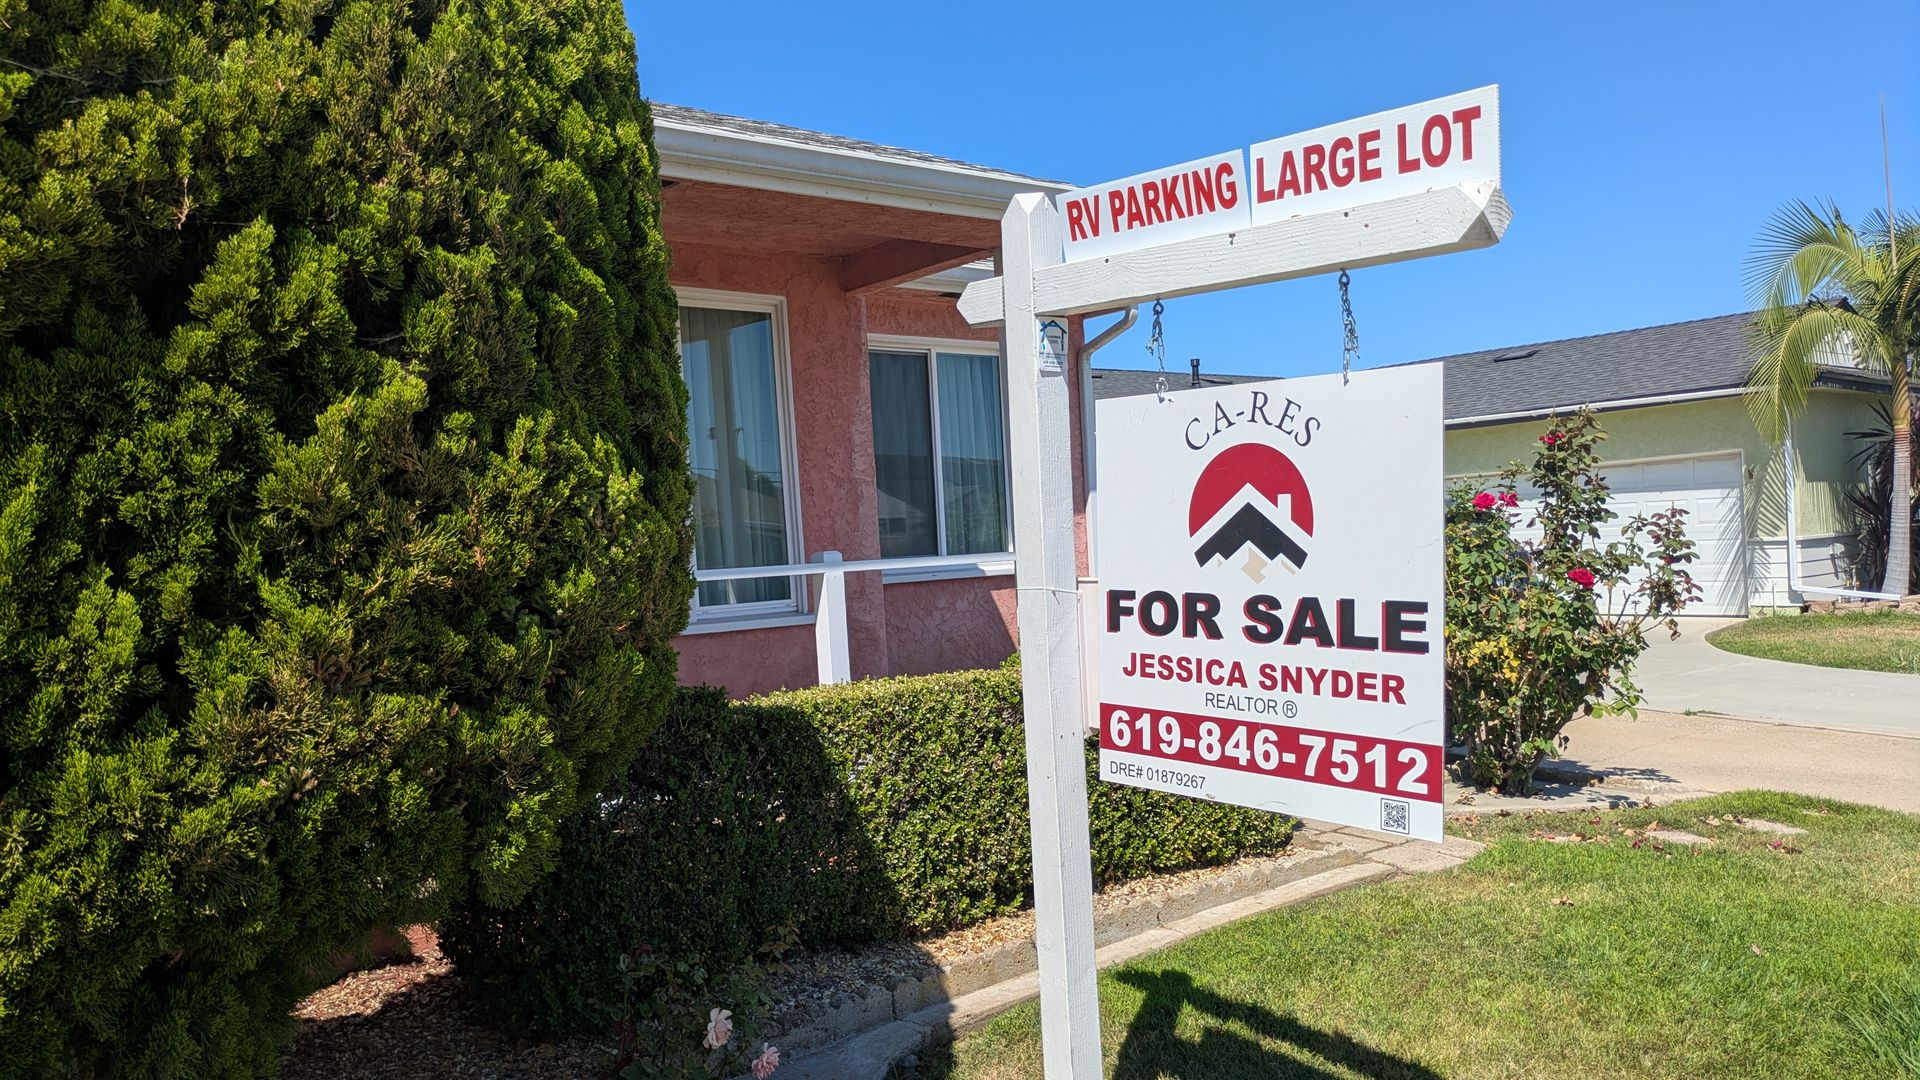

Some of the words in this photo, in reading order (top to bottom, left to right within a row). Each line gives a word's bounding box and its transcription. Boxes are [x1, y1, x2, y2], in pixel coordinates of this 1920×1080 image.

[1256, 129, 1382, 204] LARGE
[1397, 105, 1481, 175] LOT
[1066, 195, 1100, 242] RV
[1109, 162, 1237, 233] PARKING
[1185, 391, 1320, 450] CA-RES
[1106, 589, 1224, 641] FOR
[1242, 594, 1430, 654] SALE
[1122, 652, 1248, 688] JESSICA
[1258, 663, 1407, 705] SNYDER
[1205, 692, 1279, 717] REALTOR
[1109, 709, 1429, 795] 619-846-7512
[1110, 760, 1144, 780] DRE#
[1146, 767, 1206, 790] 01879267
